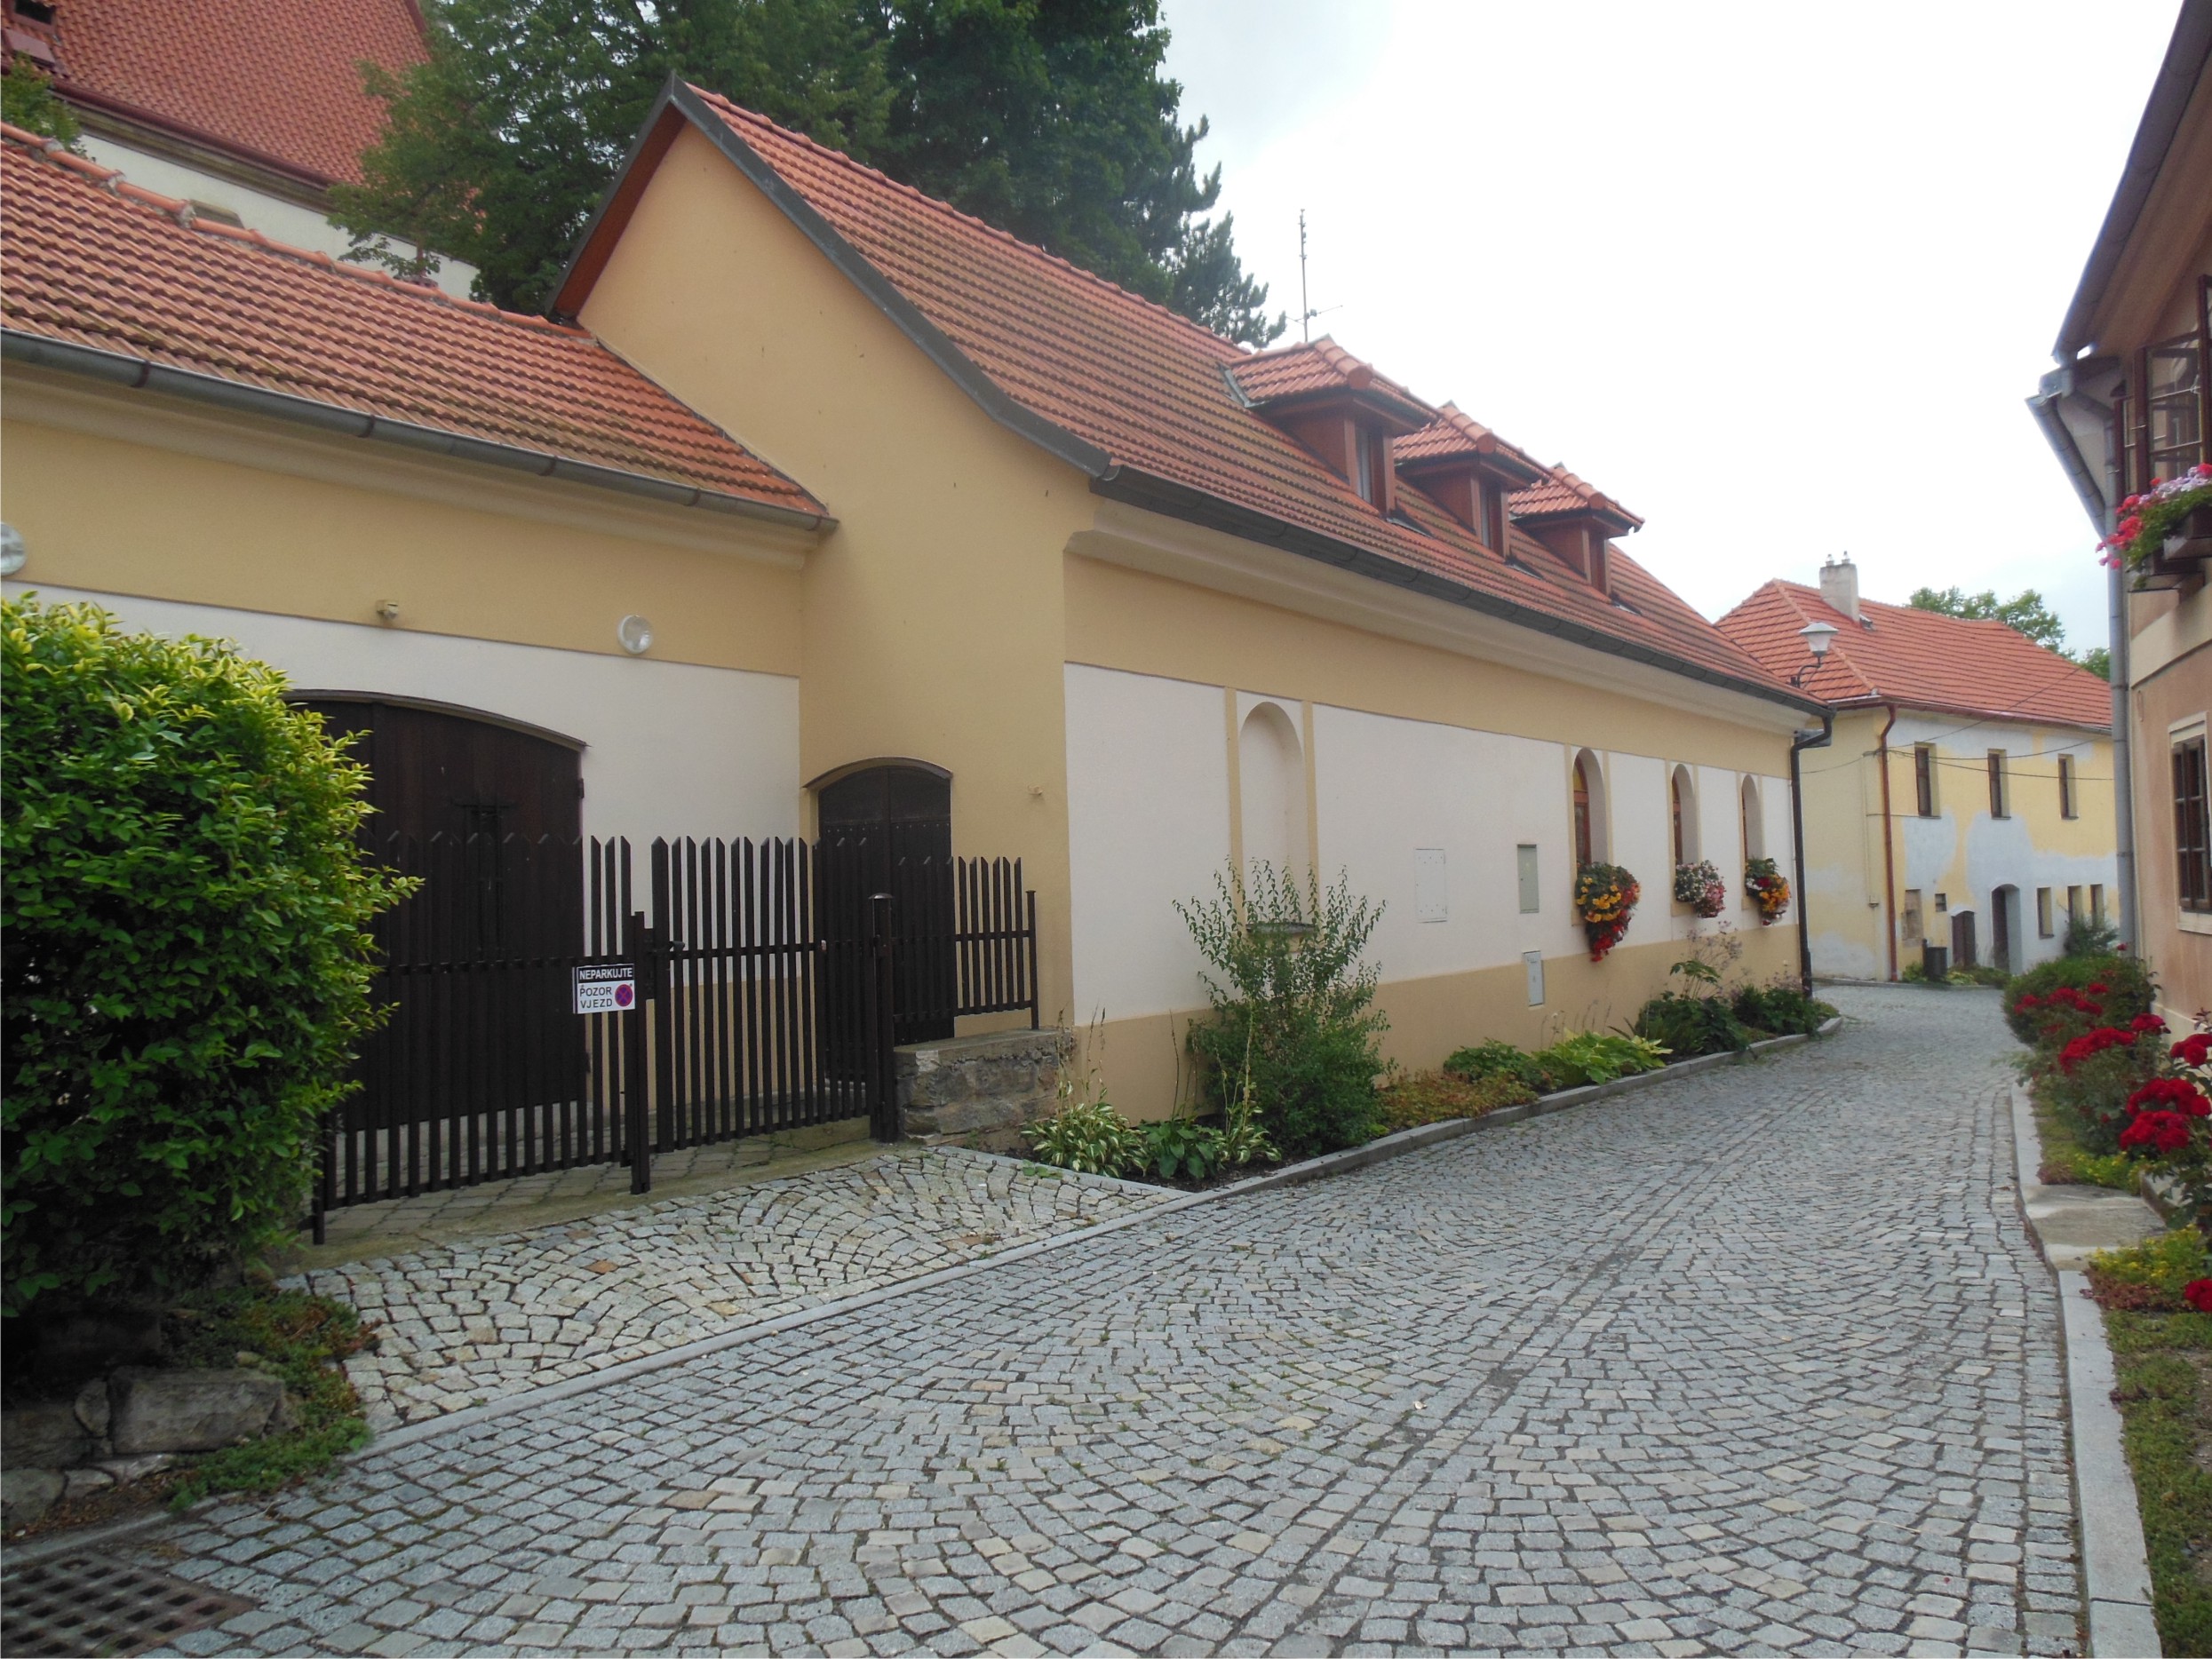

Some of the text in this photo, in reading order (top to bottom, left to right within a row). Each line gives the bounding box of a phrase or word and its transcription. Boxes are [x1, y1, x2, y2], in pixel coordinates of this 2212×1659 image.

[579, 967, 633, 980] NEPARKUJTE
[579, 987, 612, 996] POZOR
[580, 998, 613, 1008] VJEZD
